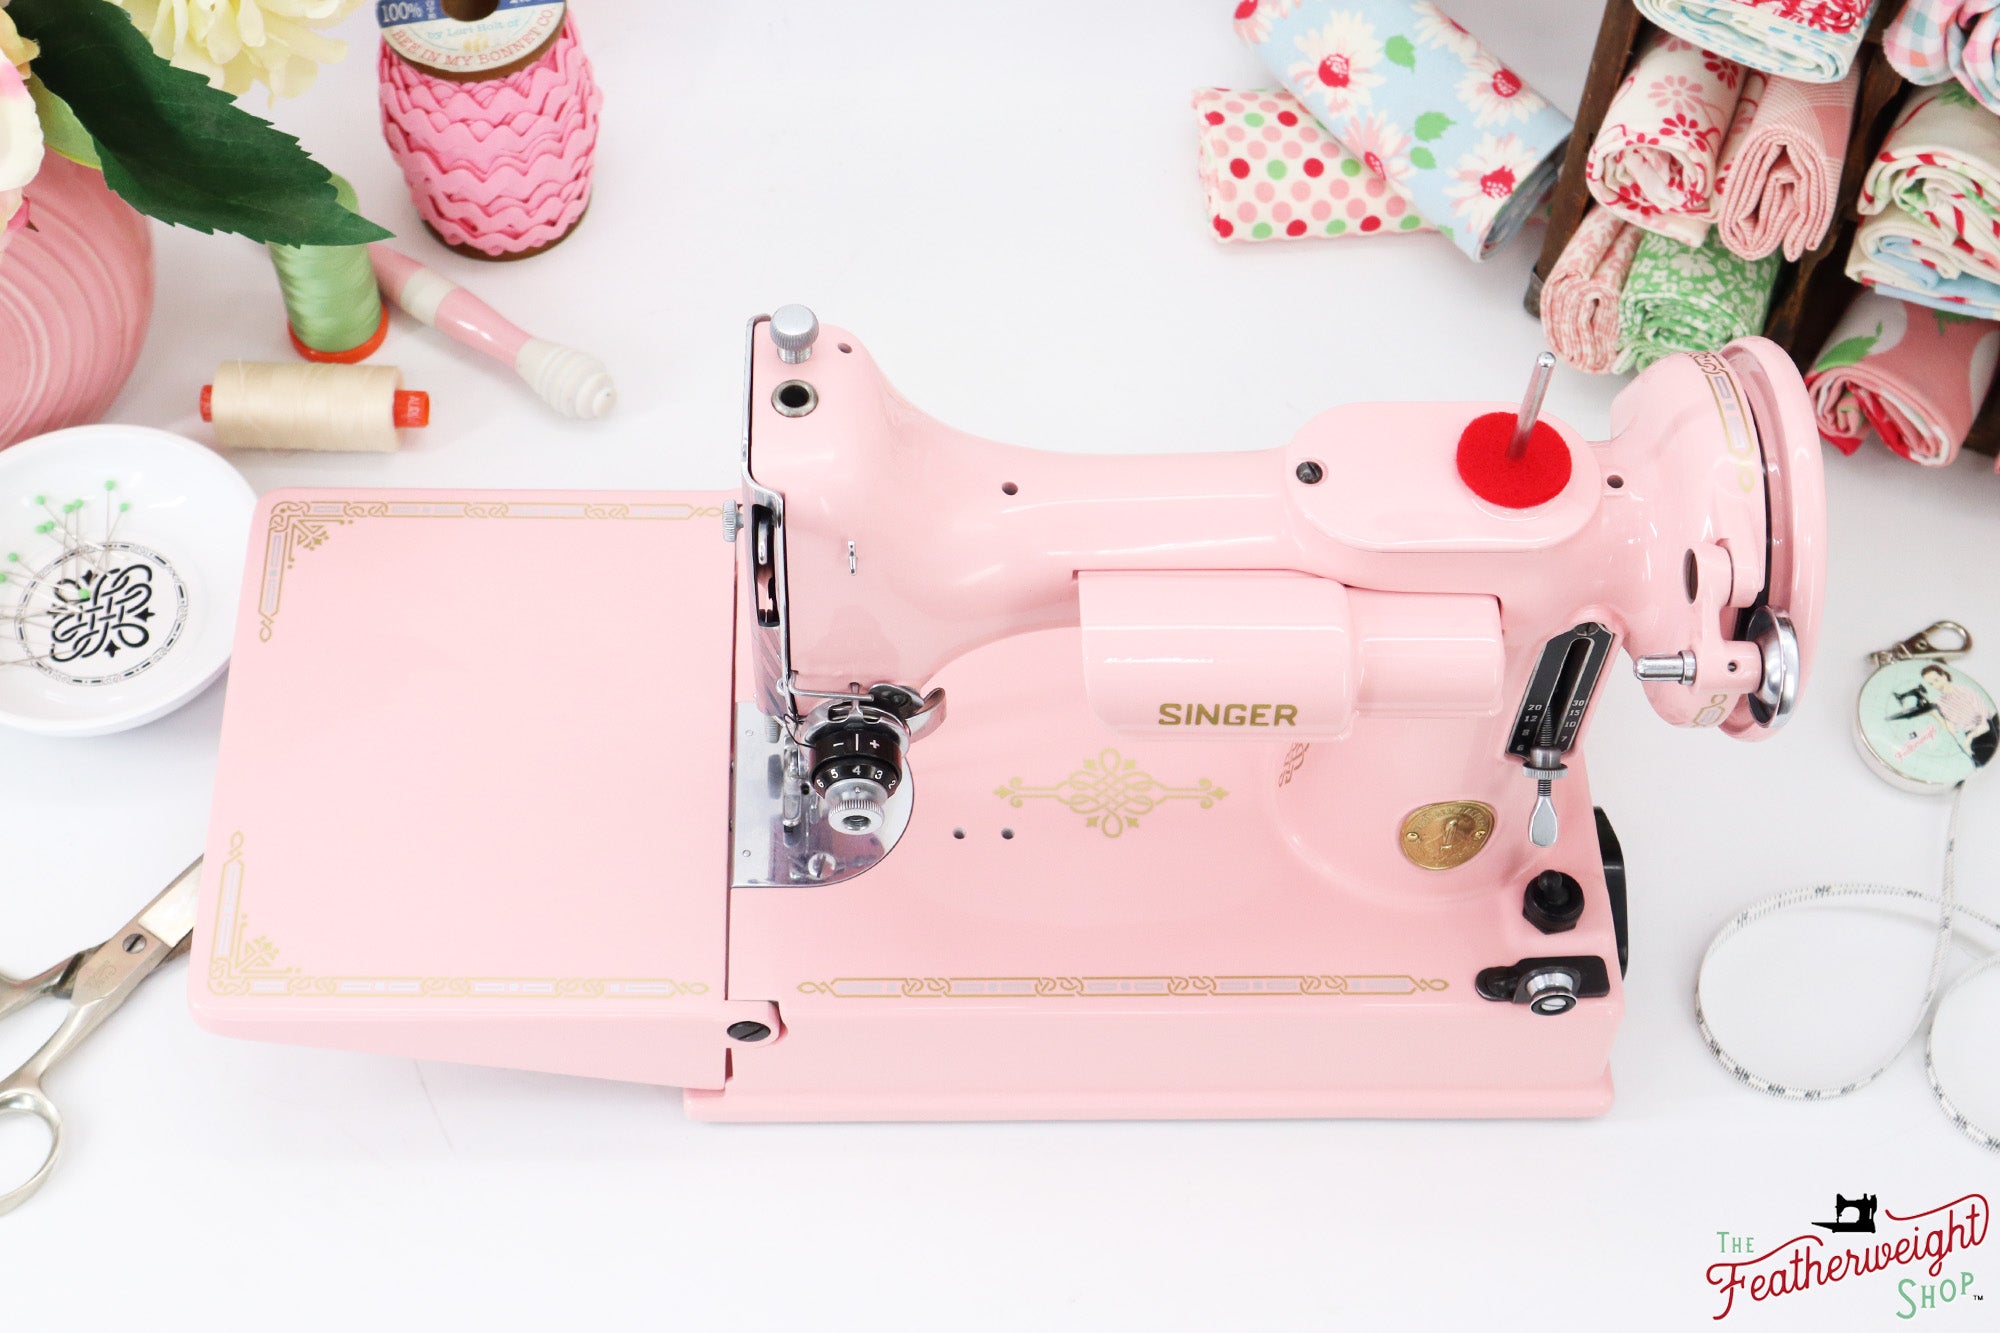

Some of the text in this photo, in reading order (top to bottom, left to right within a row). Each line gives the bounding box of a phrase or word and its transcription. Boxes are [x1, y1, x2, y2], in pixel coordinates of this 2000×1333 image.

[382, 2, 423, 22] 100%
[447, 25, 473, 36] Lori
[477, 22, 504, 33] Holt
[508, 17, 520, 28] of
[391, 30, 422, 54] BEE
[420, 48, 441, 63] IN
[444, 54, 473, 66] MY
[478, 28, 541, 64] BONNET
[1572, 699, 1585, 707] 30
[1158, 703, 1299, 727] SINGER
[830, 768, 839, 779] 5
[852, 765, 861, 776] 4
[874, 770, 883, 780] 3
[888, 780, 897, 790] 2
